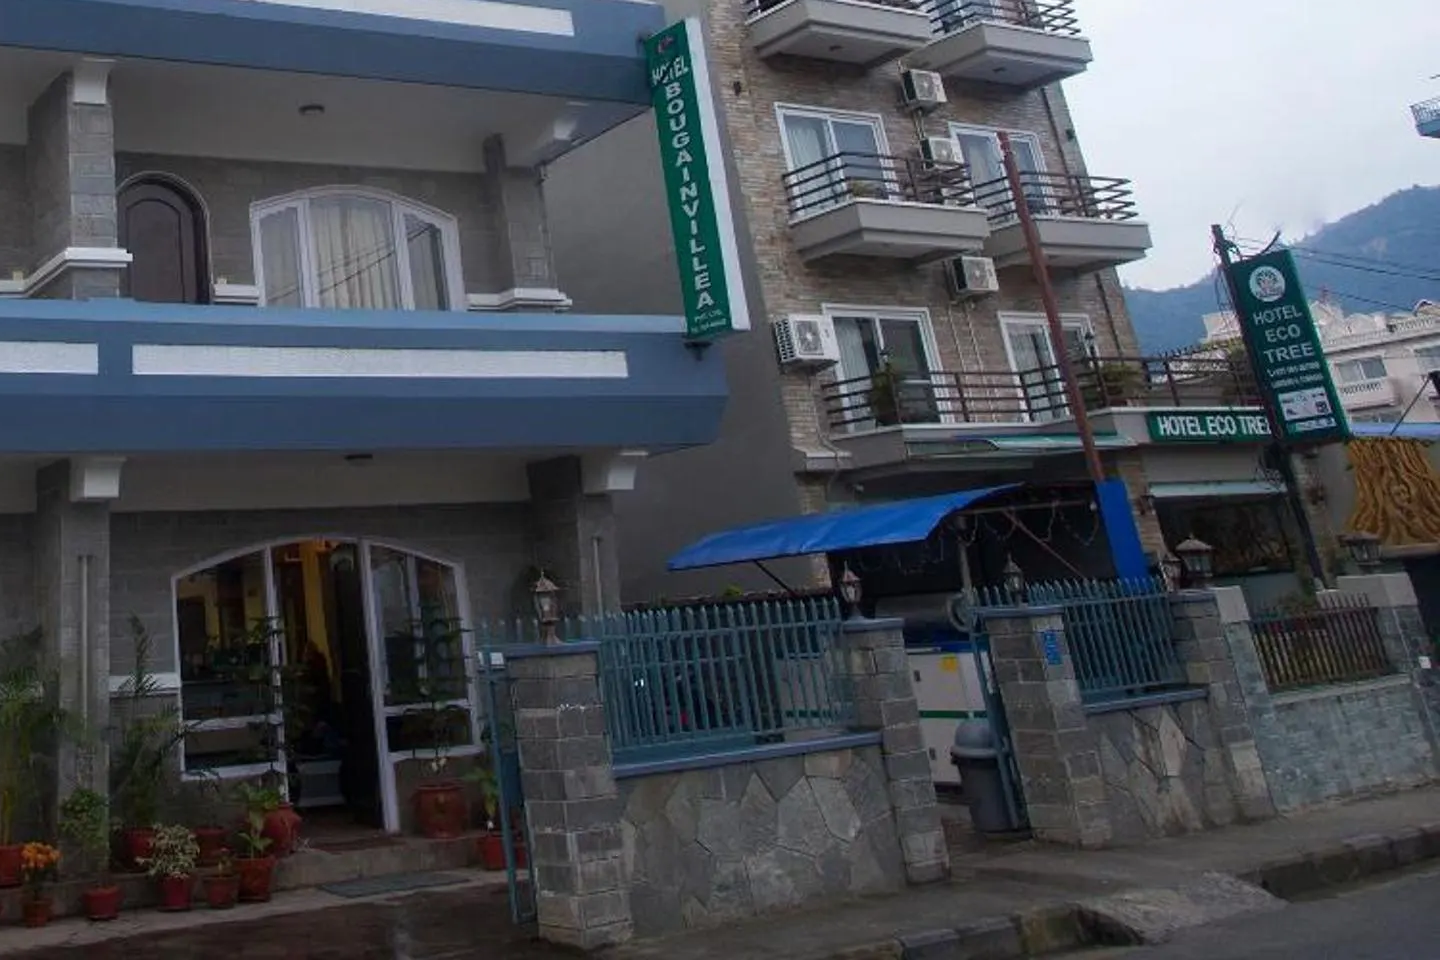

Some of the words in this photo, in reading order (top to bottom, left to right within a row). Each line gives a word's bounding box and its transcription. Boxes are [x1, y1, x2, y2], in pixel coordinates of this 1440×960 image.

[665, 82, 714, 310] BOUGAINVILLEA
[1253, 305, 1302, 324] HOTEL
[1265, 324, 1301, 343] ECO
[1264, 343, 1314, 363] TREE
[1157, 415, 1207, 436] HOTEL
[1206, 415, 1237, 435] ECO
